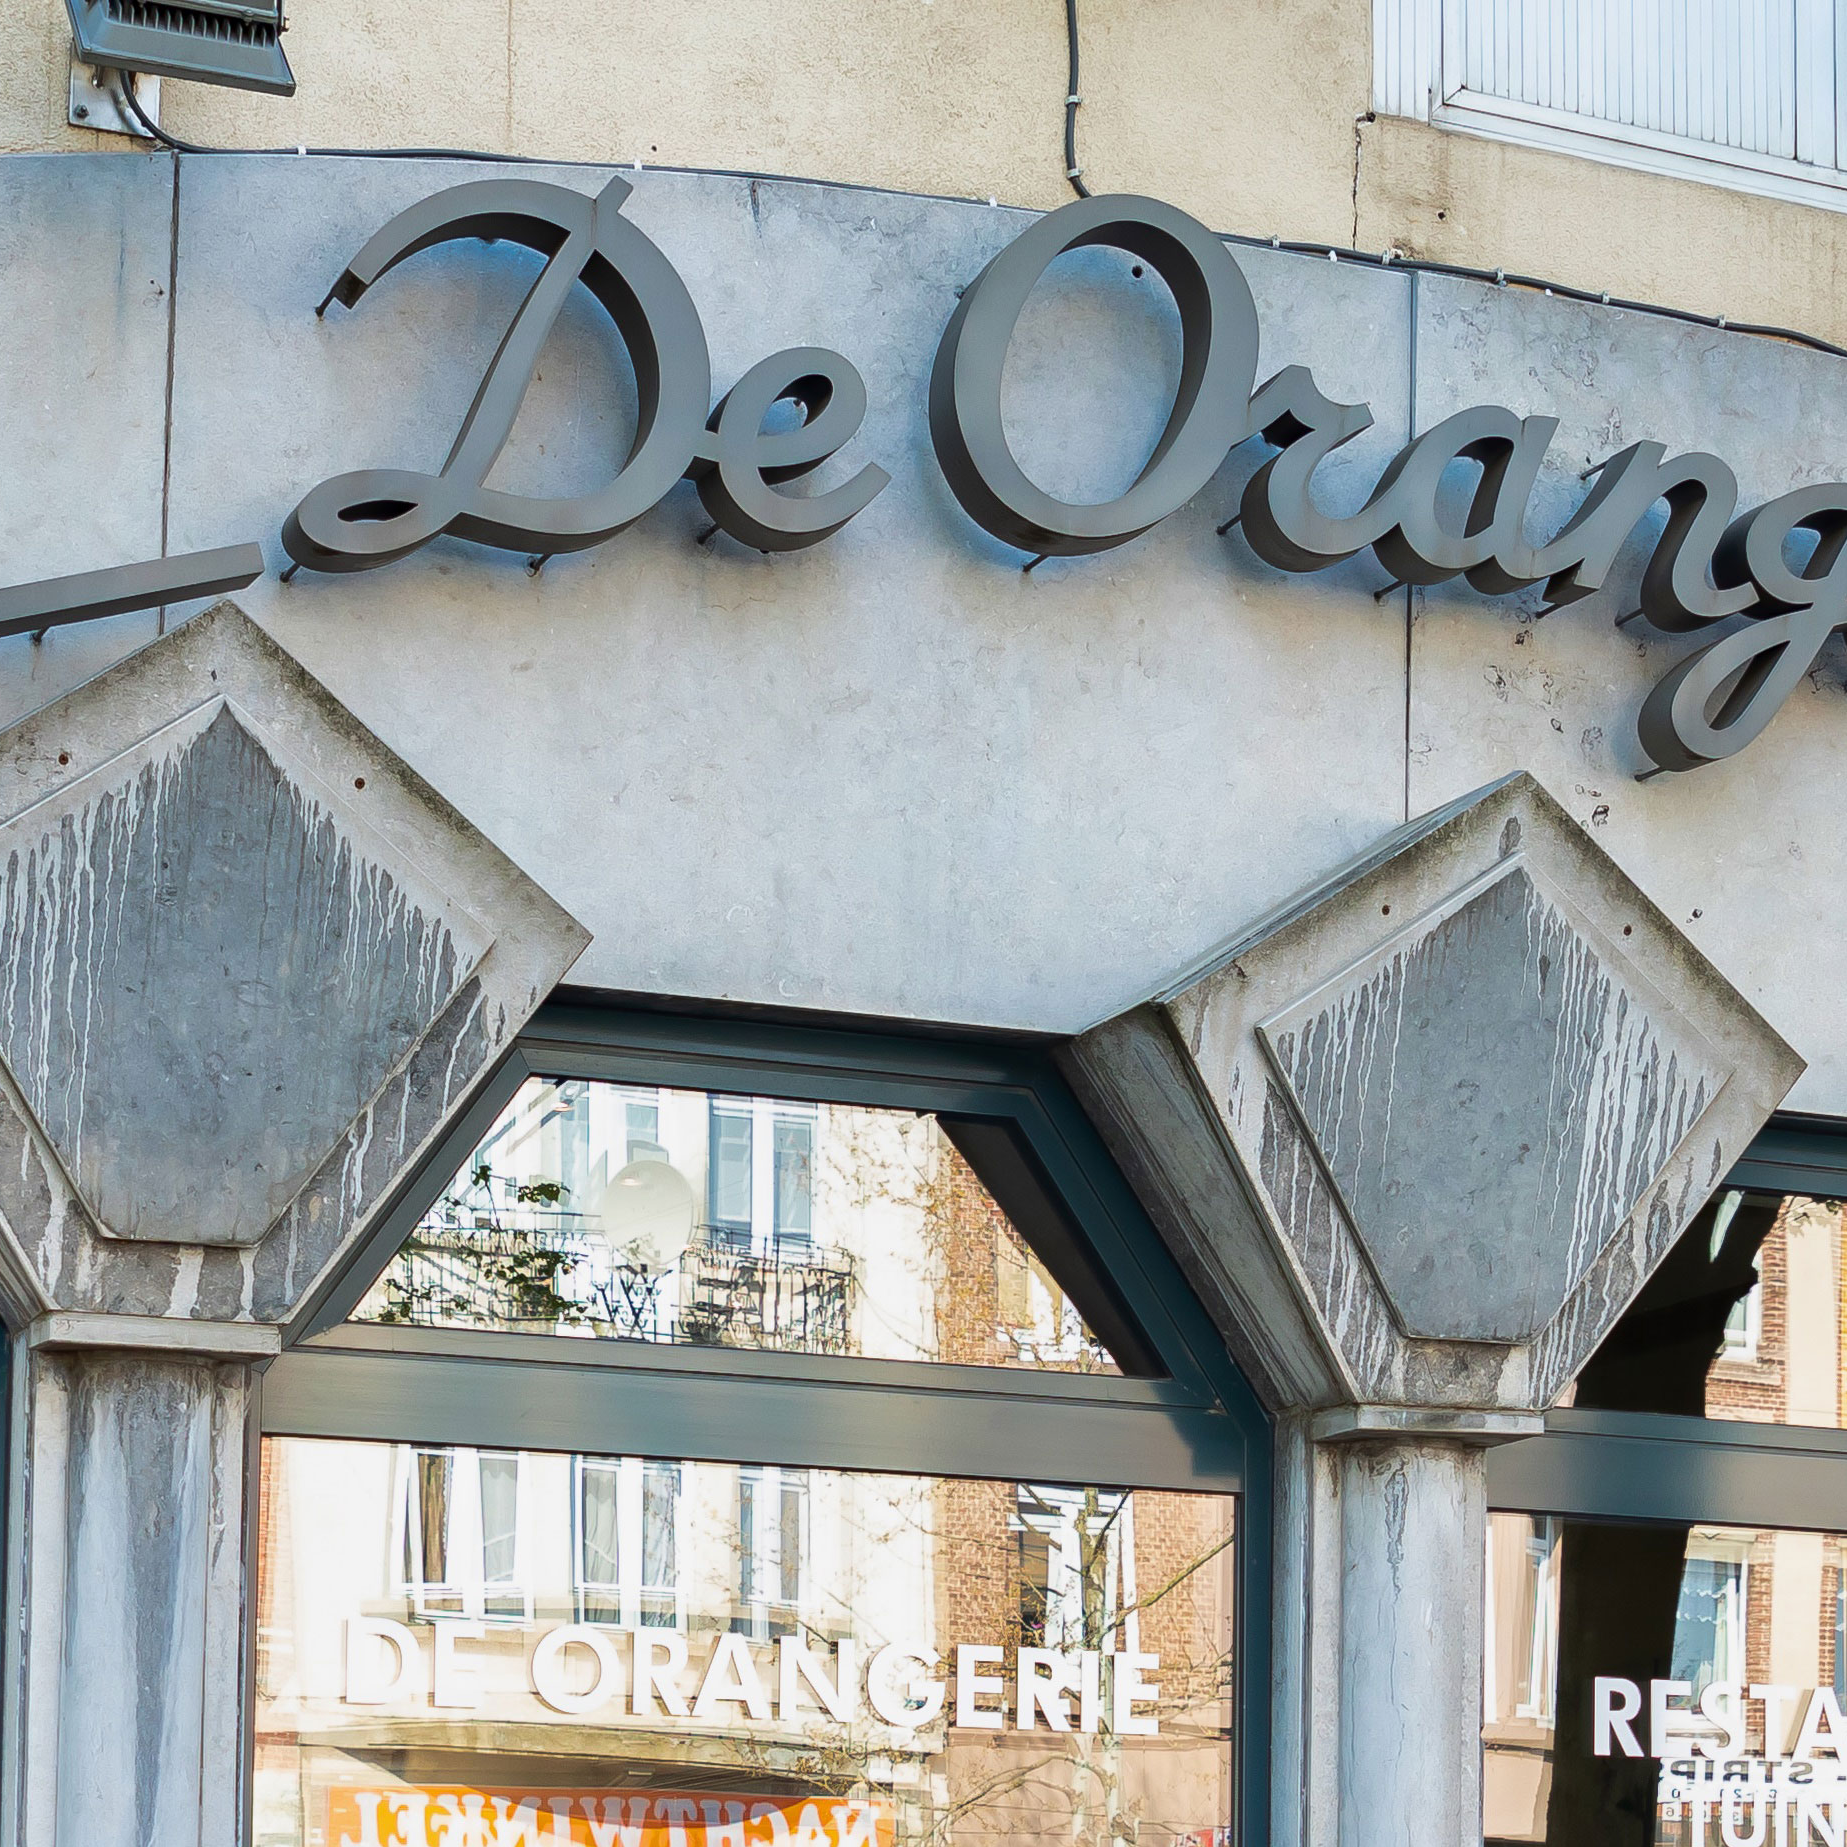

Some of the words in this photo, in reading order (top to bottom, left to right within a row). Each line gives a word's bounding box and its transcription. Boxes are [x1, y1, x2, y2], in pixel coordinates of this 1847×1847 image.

[283, 175, 891, 574] De
[345, 1616, 484, 1707] DE
[532, 1625, 1159, 1736] ORANGERIE
